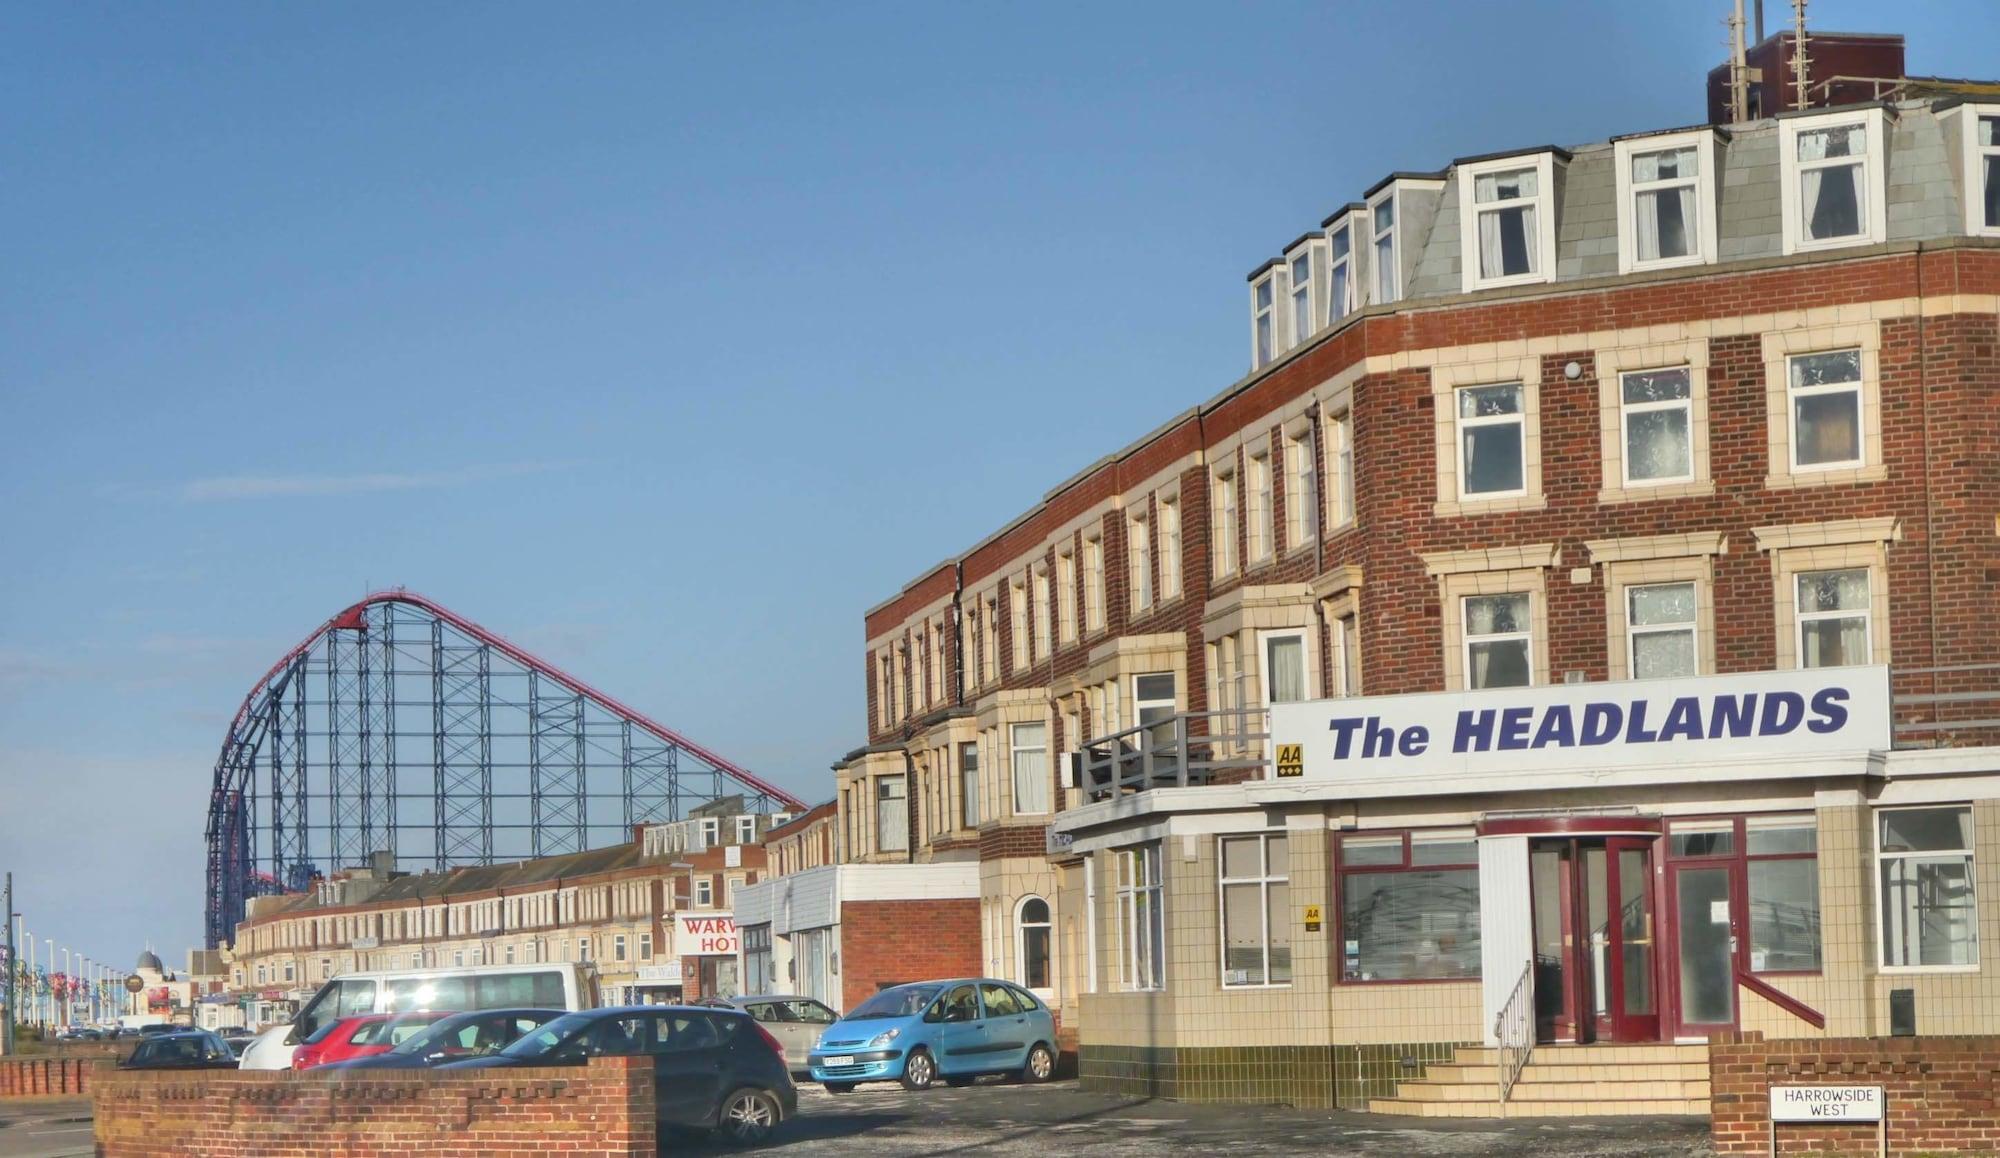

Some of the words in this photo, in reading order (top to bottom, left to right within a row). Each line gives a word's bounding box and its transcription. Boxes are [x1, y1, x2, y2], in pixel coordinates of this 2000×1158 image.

[1329, 716, 1430, 760] The
[1452, 686, 1850, 754] HEADLANDS
[1279, 745, 1301, 764] AA
[1306, 908, 1319, 919] AA
[1784, 1089, 1874, 1102] HARROWSIDE
[1810, 1103, 1848, 1116] WEST
